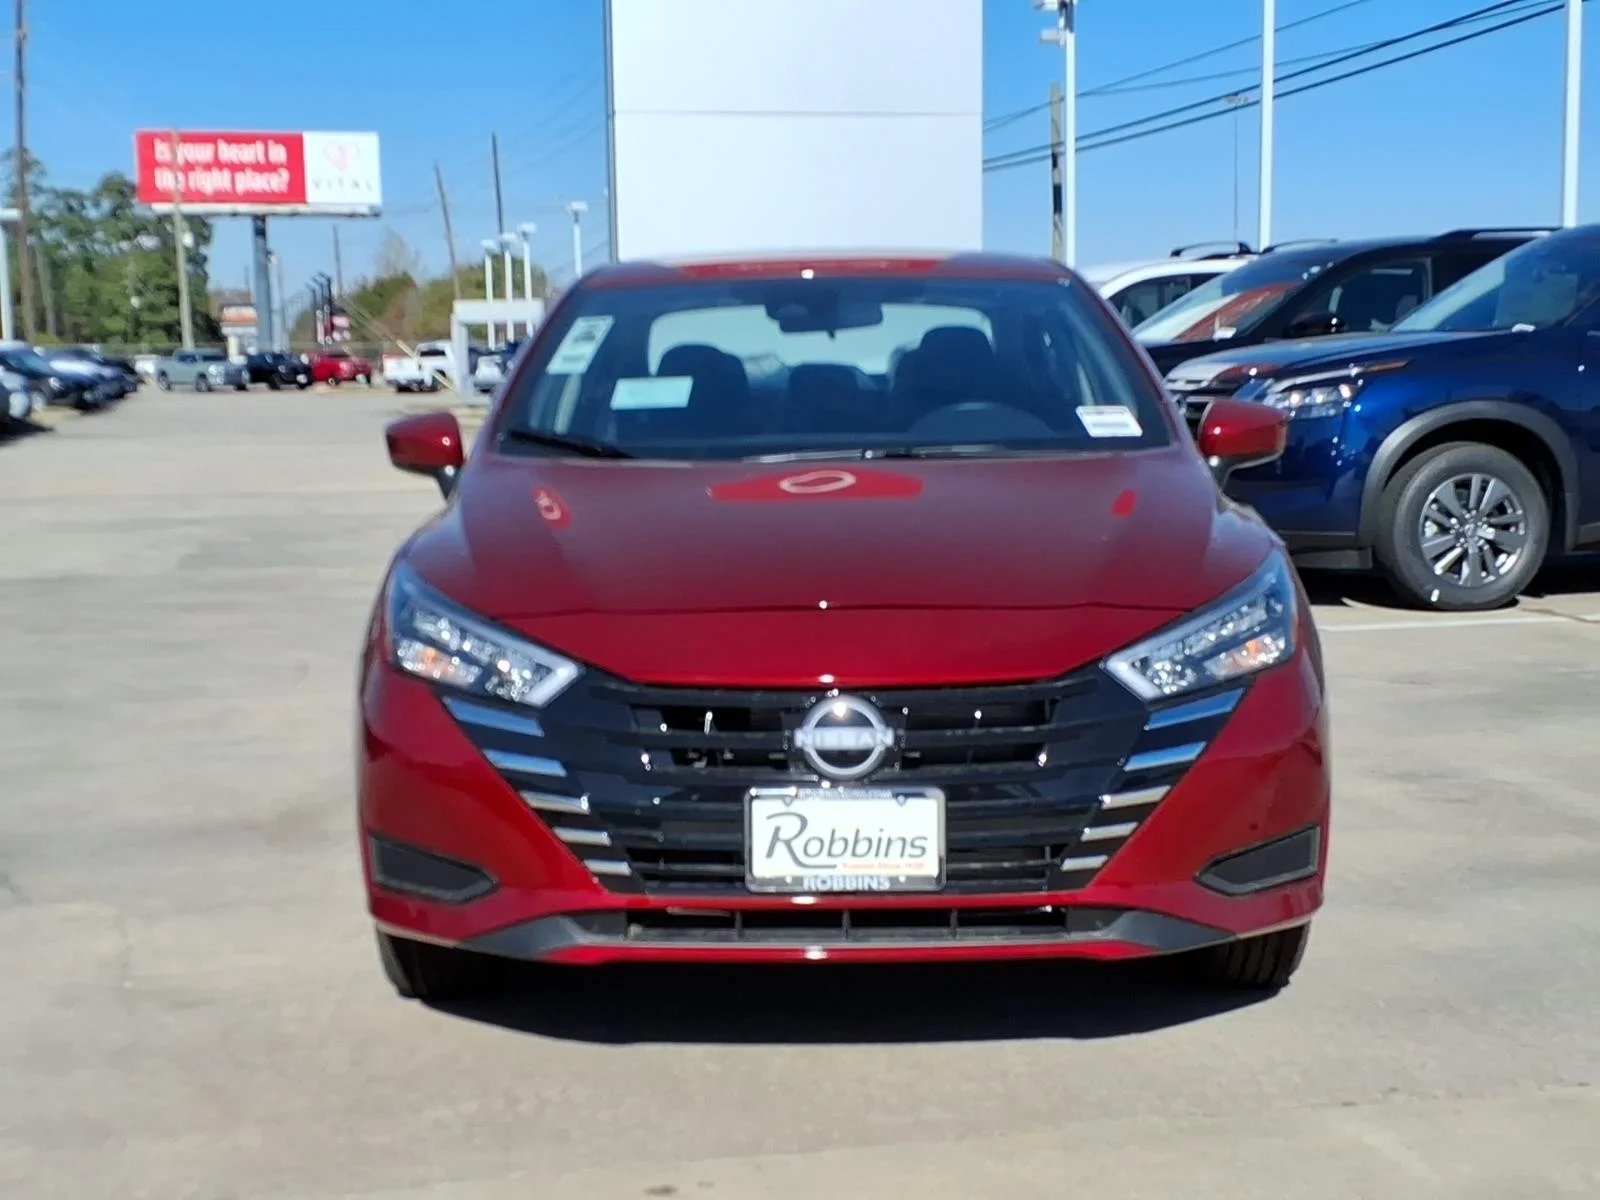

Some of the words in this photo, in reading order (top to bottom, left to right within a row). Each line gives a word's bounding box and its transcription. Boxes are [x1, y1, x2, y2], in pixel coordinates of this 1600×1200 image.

[153, 138, 171, 163] Is
[176, 141, 215, 166] your
[217, 140, 265, 165] heart
[268, 140, 287, 165] in
[154, 166, 186, 193] the
[188, 167, 232, 197] right
[235, 167, 290, 195] place?
[312, 178, 373, 192] VITAL
[766, 812, 928, 869] Robbins
[804, 875, 890, 890] ROBBINS
